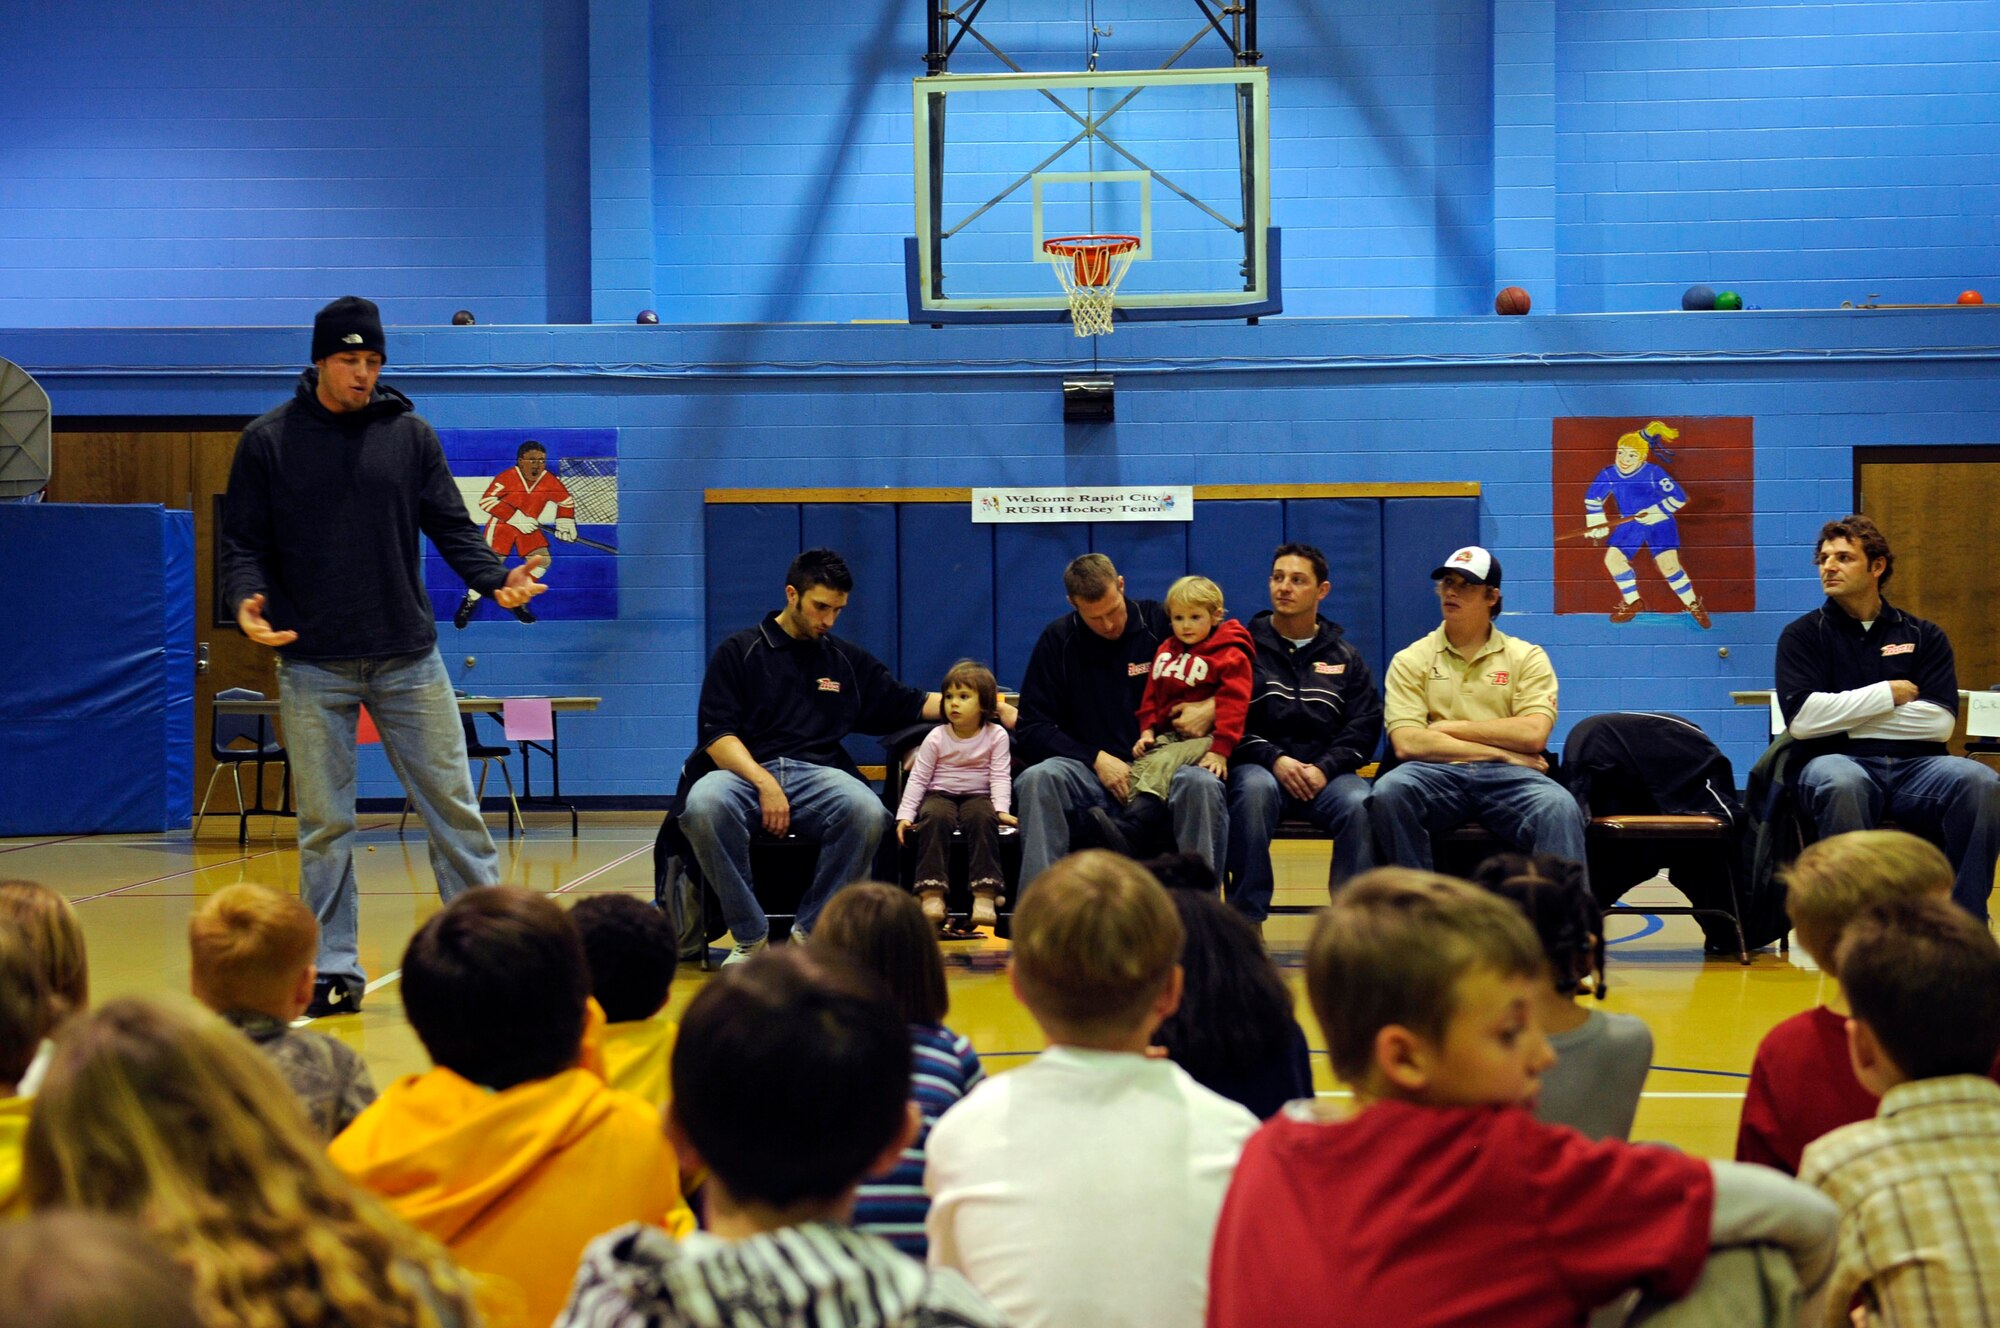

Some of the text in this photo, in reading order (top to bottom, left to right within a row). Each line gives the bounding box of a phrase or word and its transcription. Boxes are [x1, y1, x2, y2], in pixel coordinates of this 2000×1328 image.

[490, 482, 505, 496] 7
[1658, 477, 1675, 492] 8
[1005, 493, 1161, 504] Welcome Rapid City
[1005, 505, 1162, 515] RUSH Hockey Team
[1152, 652, 1209, 687] GAP
